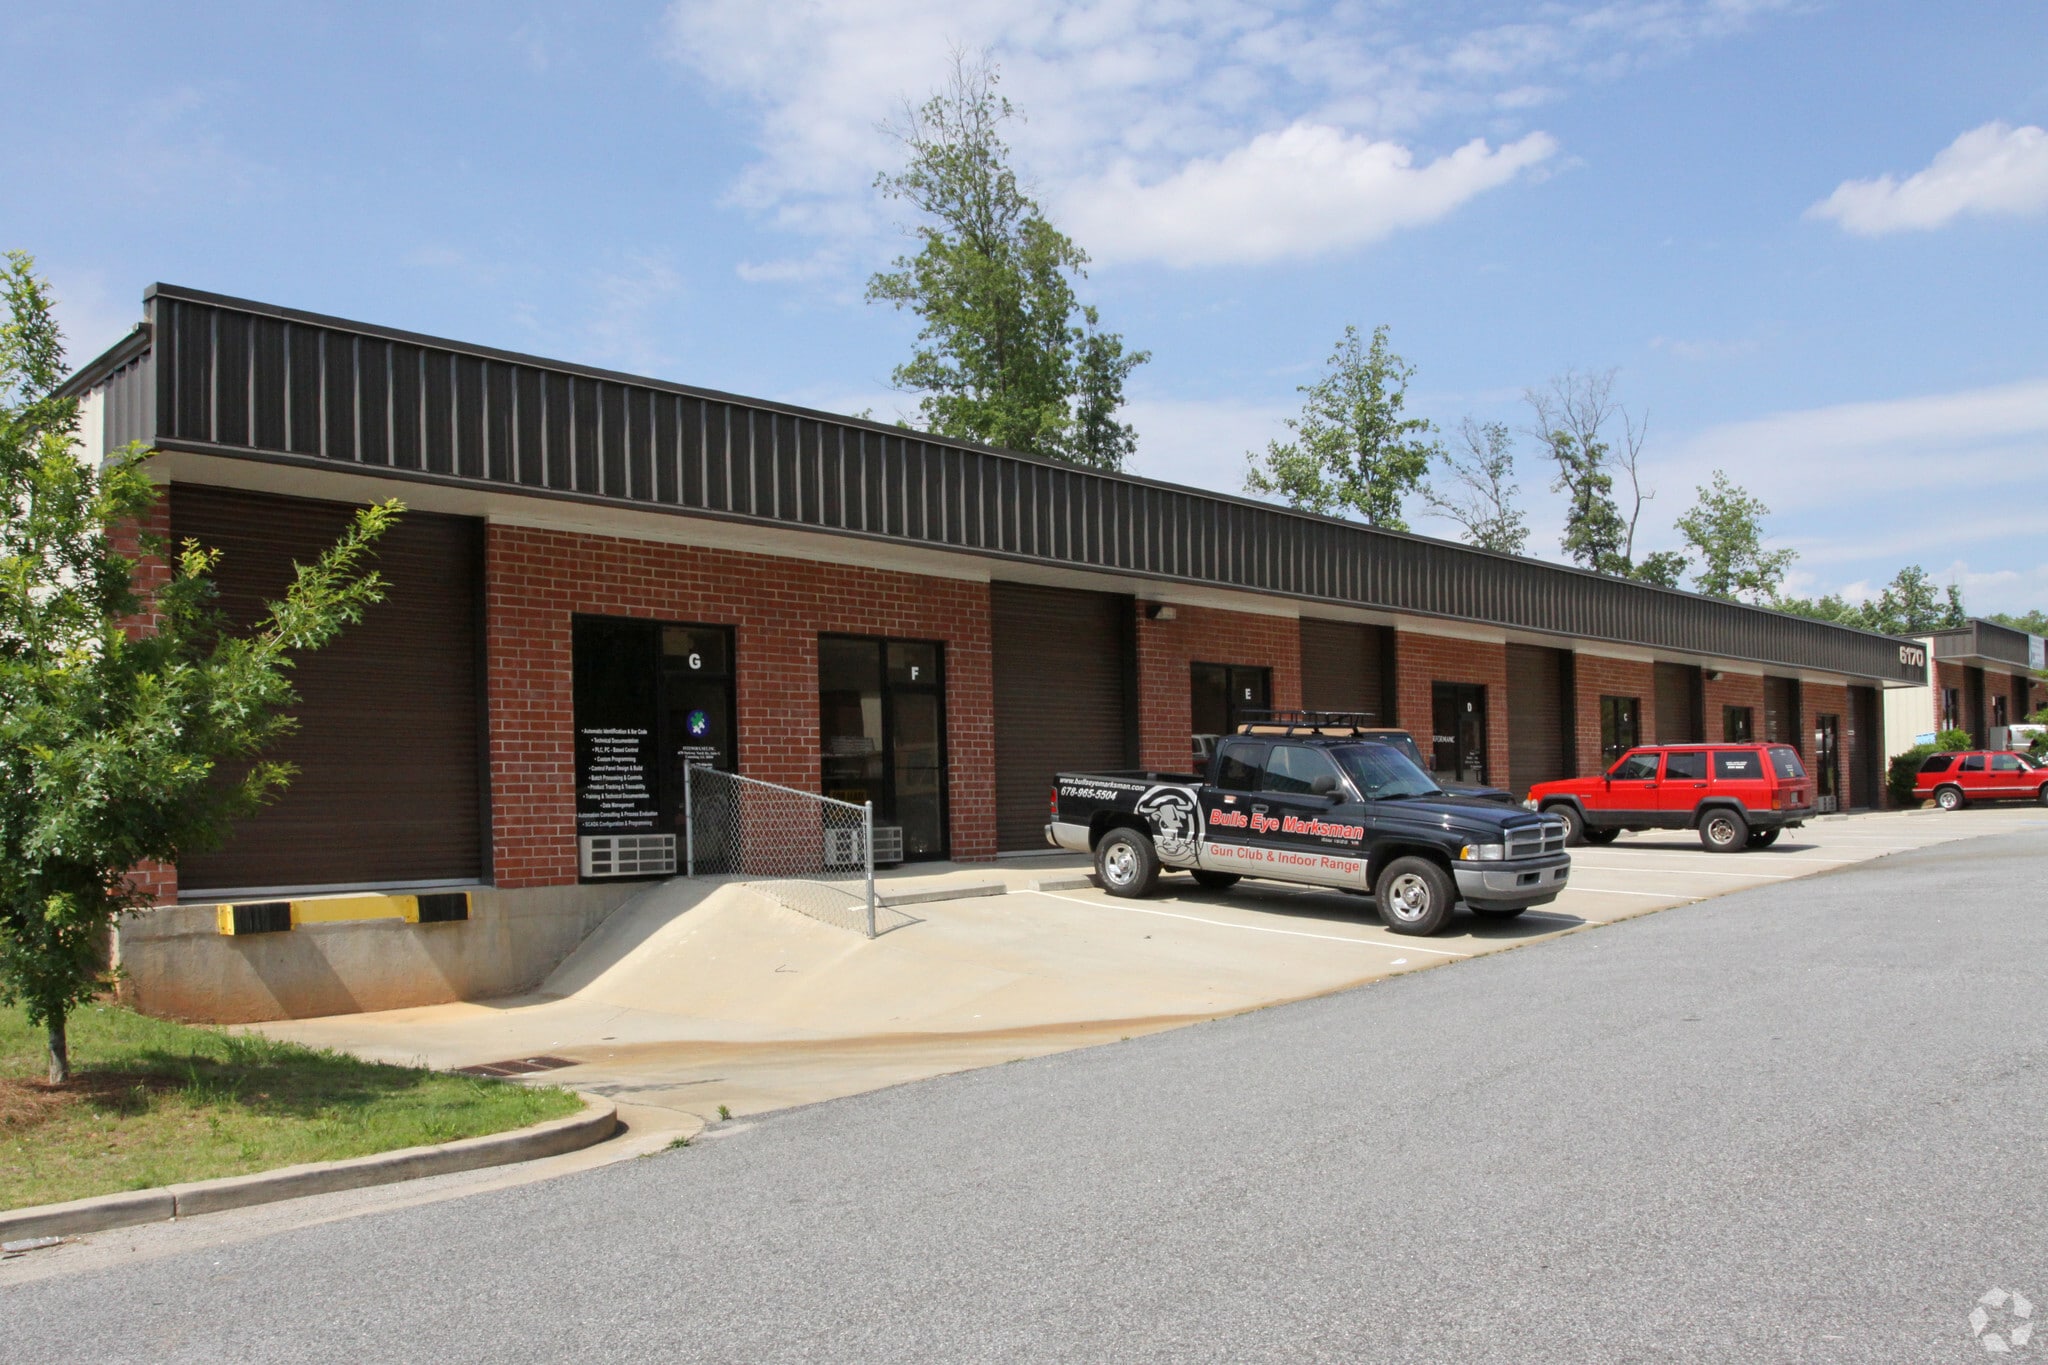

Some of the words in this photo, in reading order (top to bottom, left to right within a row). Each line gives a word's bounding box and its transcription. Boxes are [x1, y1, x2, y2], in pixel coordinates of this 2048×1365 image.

[689, 653, 701, 670] G
[911, 666, 919, 680] F
[1245, 688, 1251, 700] E
[1467, 702, 1472, 712] D
[1059, 777, 1146, 792] www.bullseyemarksman.com
[1060, 786, 1118, 801] 678-965-5504
[1209, 808, 1248, 828] Bulls
[1250, 812, 1279, 834] Eye
[1281, 815, 1365, 840] Marksman
[1210, 844, 1234, 858] Gun
[1236, 846, 1264, 861] Club
[1266, 850, 1275, 863] &
[1278, 851, 1318, 868] Indoor
[1320, 856, 1361, 874] Range
